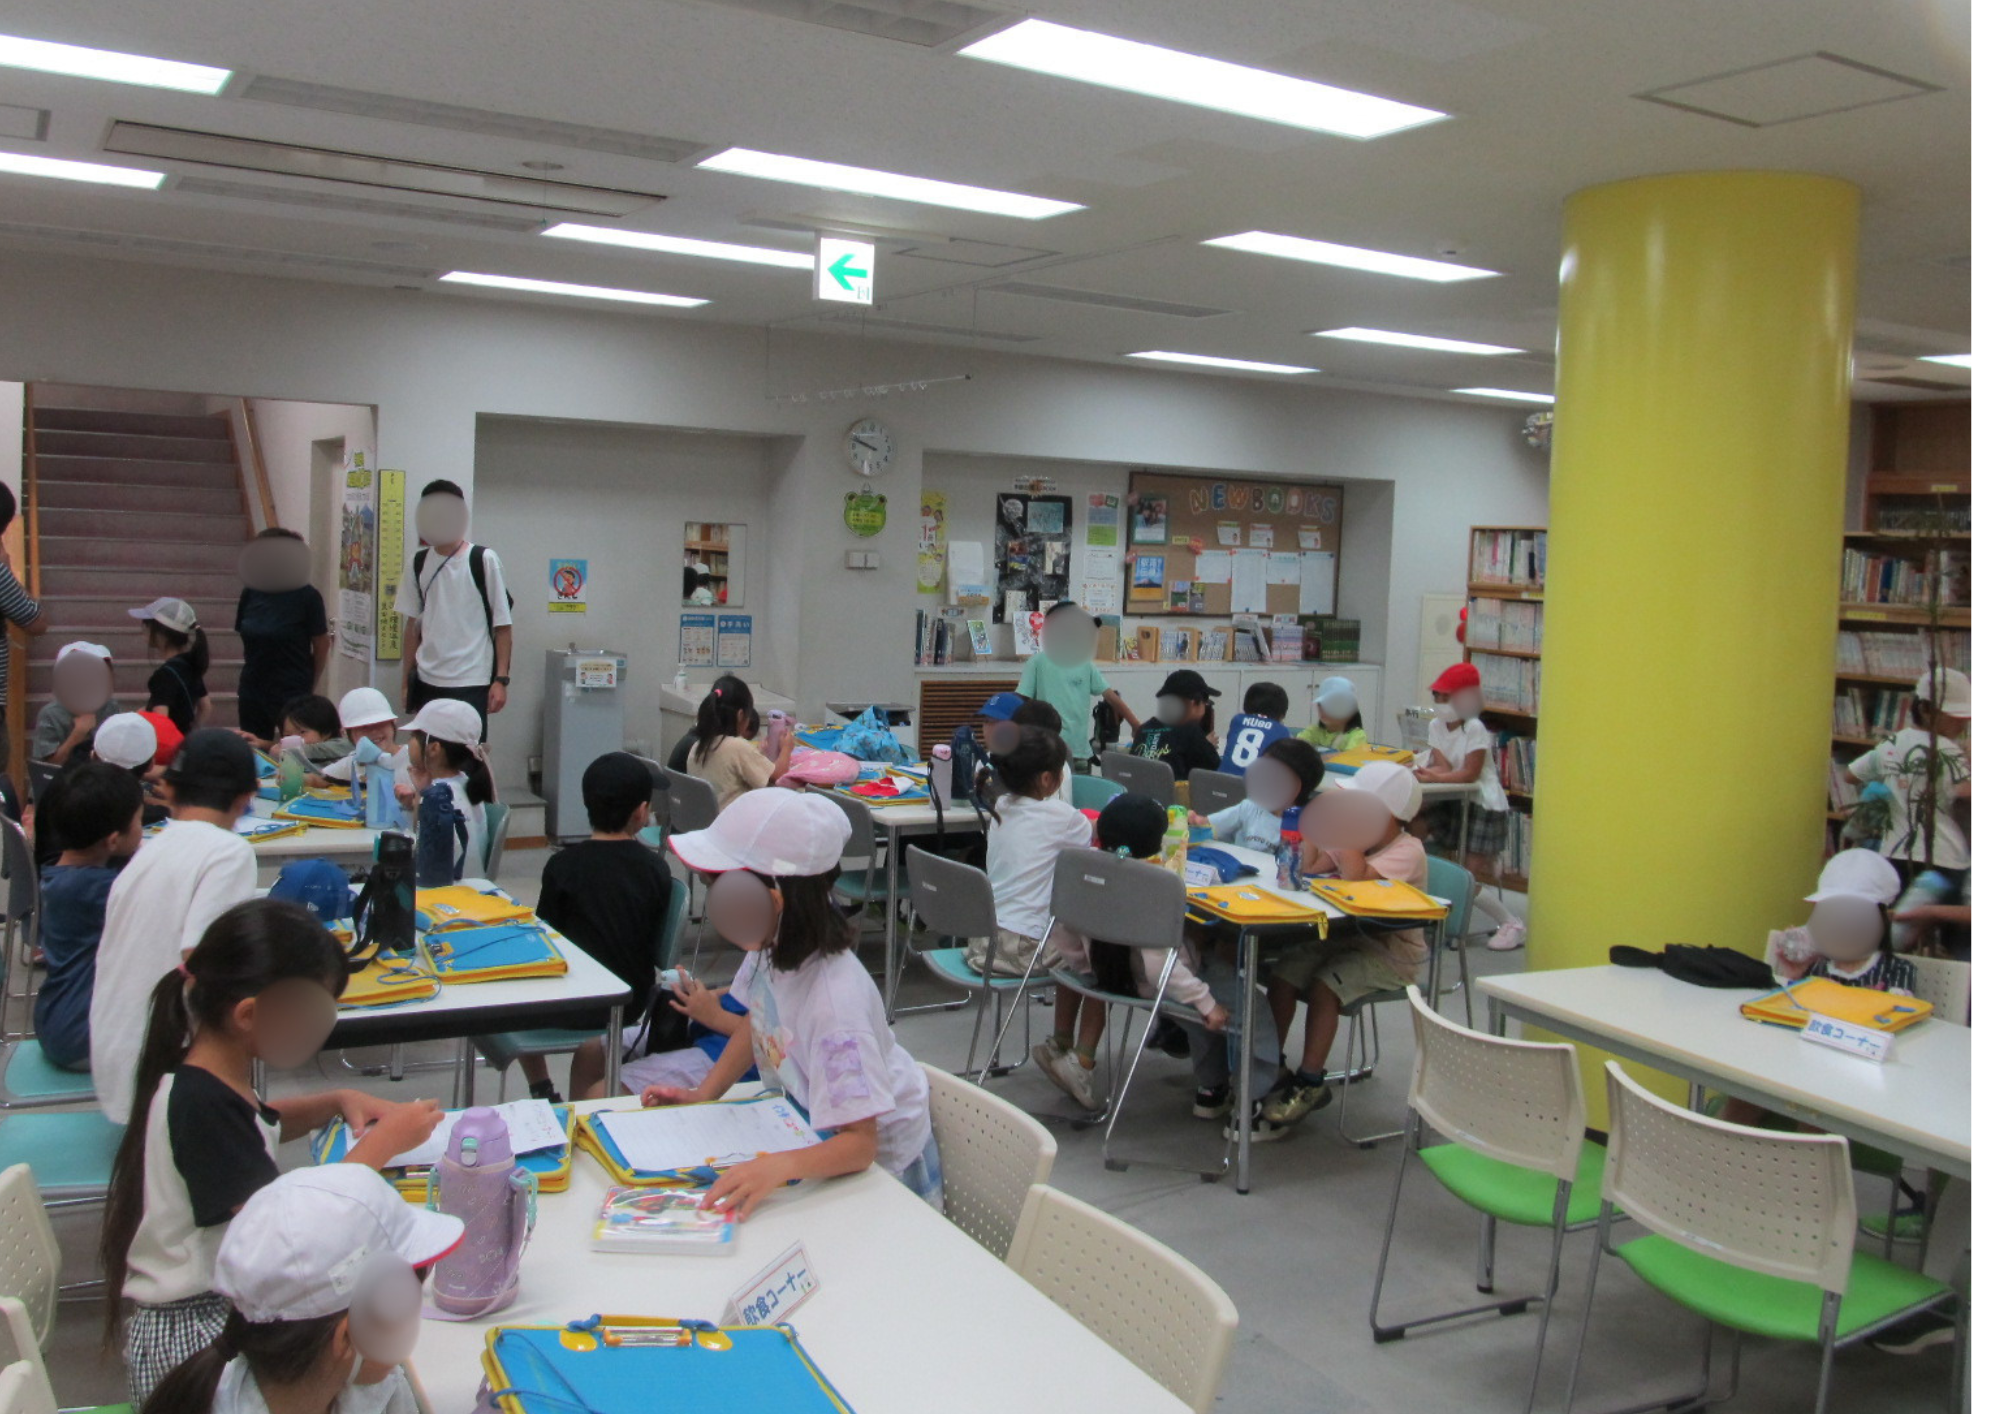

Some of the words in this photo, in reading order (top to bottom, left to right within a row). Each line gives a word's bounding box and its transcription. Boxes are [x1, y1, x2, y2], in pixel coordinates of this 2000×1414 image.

[1231, 728, 1265, 767] 8
[1808, 1020, 1881, 1048] 飲食コーナー
[743, 1268, 806, 1326] 飲食コーナー
